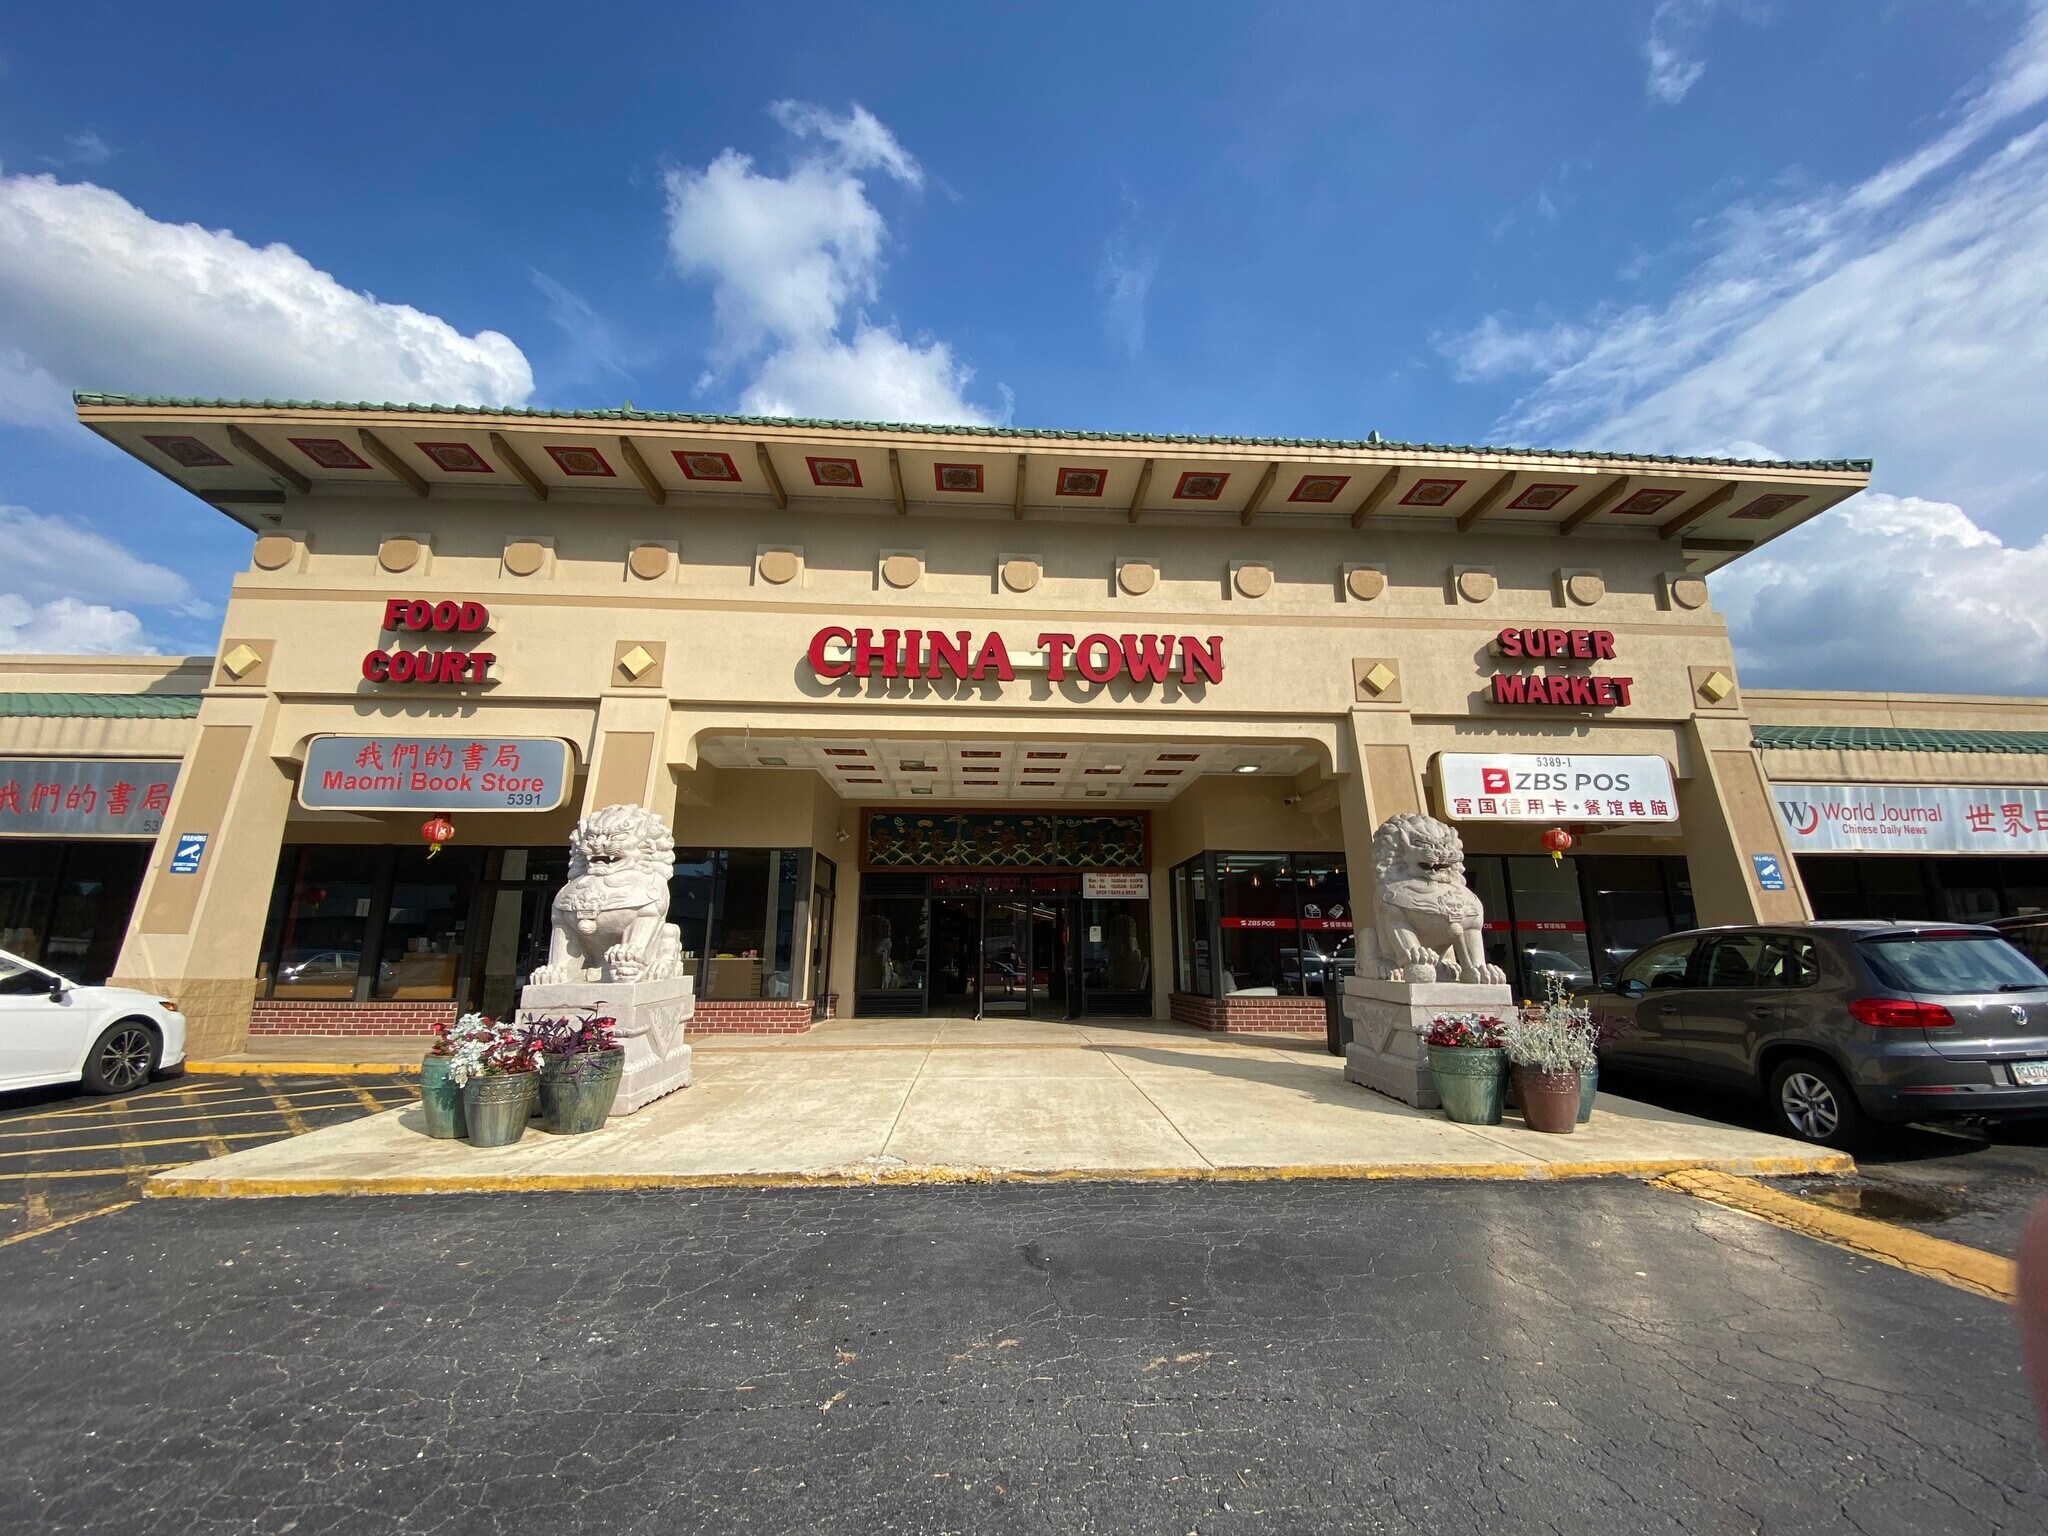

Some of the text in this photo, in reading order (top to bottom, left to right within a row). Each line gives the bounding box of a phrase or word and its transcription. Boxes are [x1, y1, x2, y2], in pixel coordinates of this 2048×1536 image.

[383, 599, 490, 632] FOOD
[807, 626, 1224, 684] CHINA TOWN
[1497, 628, 1617, 660] SUPER
[362, 650, 497, 684] COURT
[1491, 674, 1633, 707] MARKET
[354, 741, 521, 772] 我們的書局
[322, 770, 544, 793] Maomi Book Store
[1515, 773, 1630, 791] ZBS POS
[507, 794, 541, 806] 5391
[1821, 802, 1942, 822] World Journal
[143, 820, 163, 832] 53
[1842, 823, 1928, 836] Chinese Daily News
